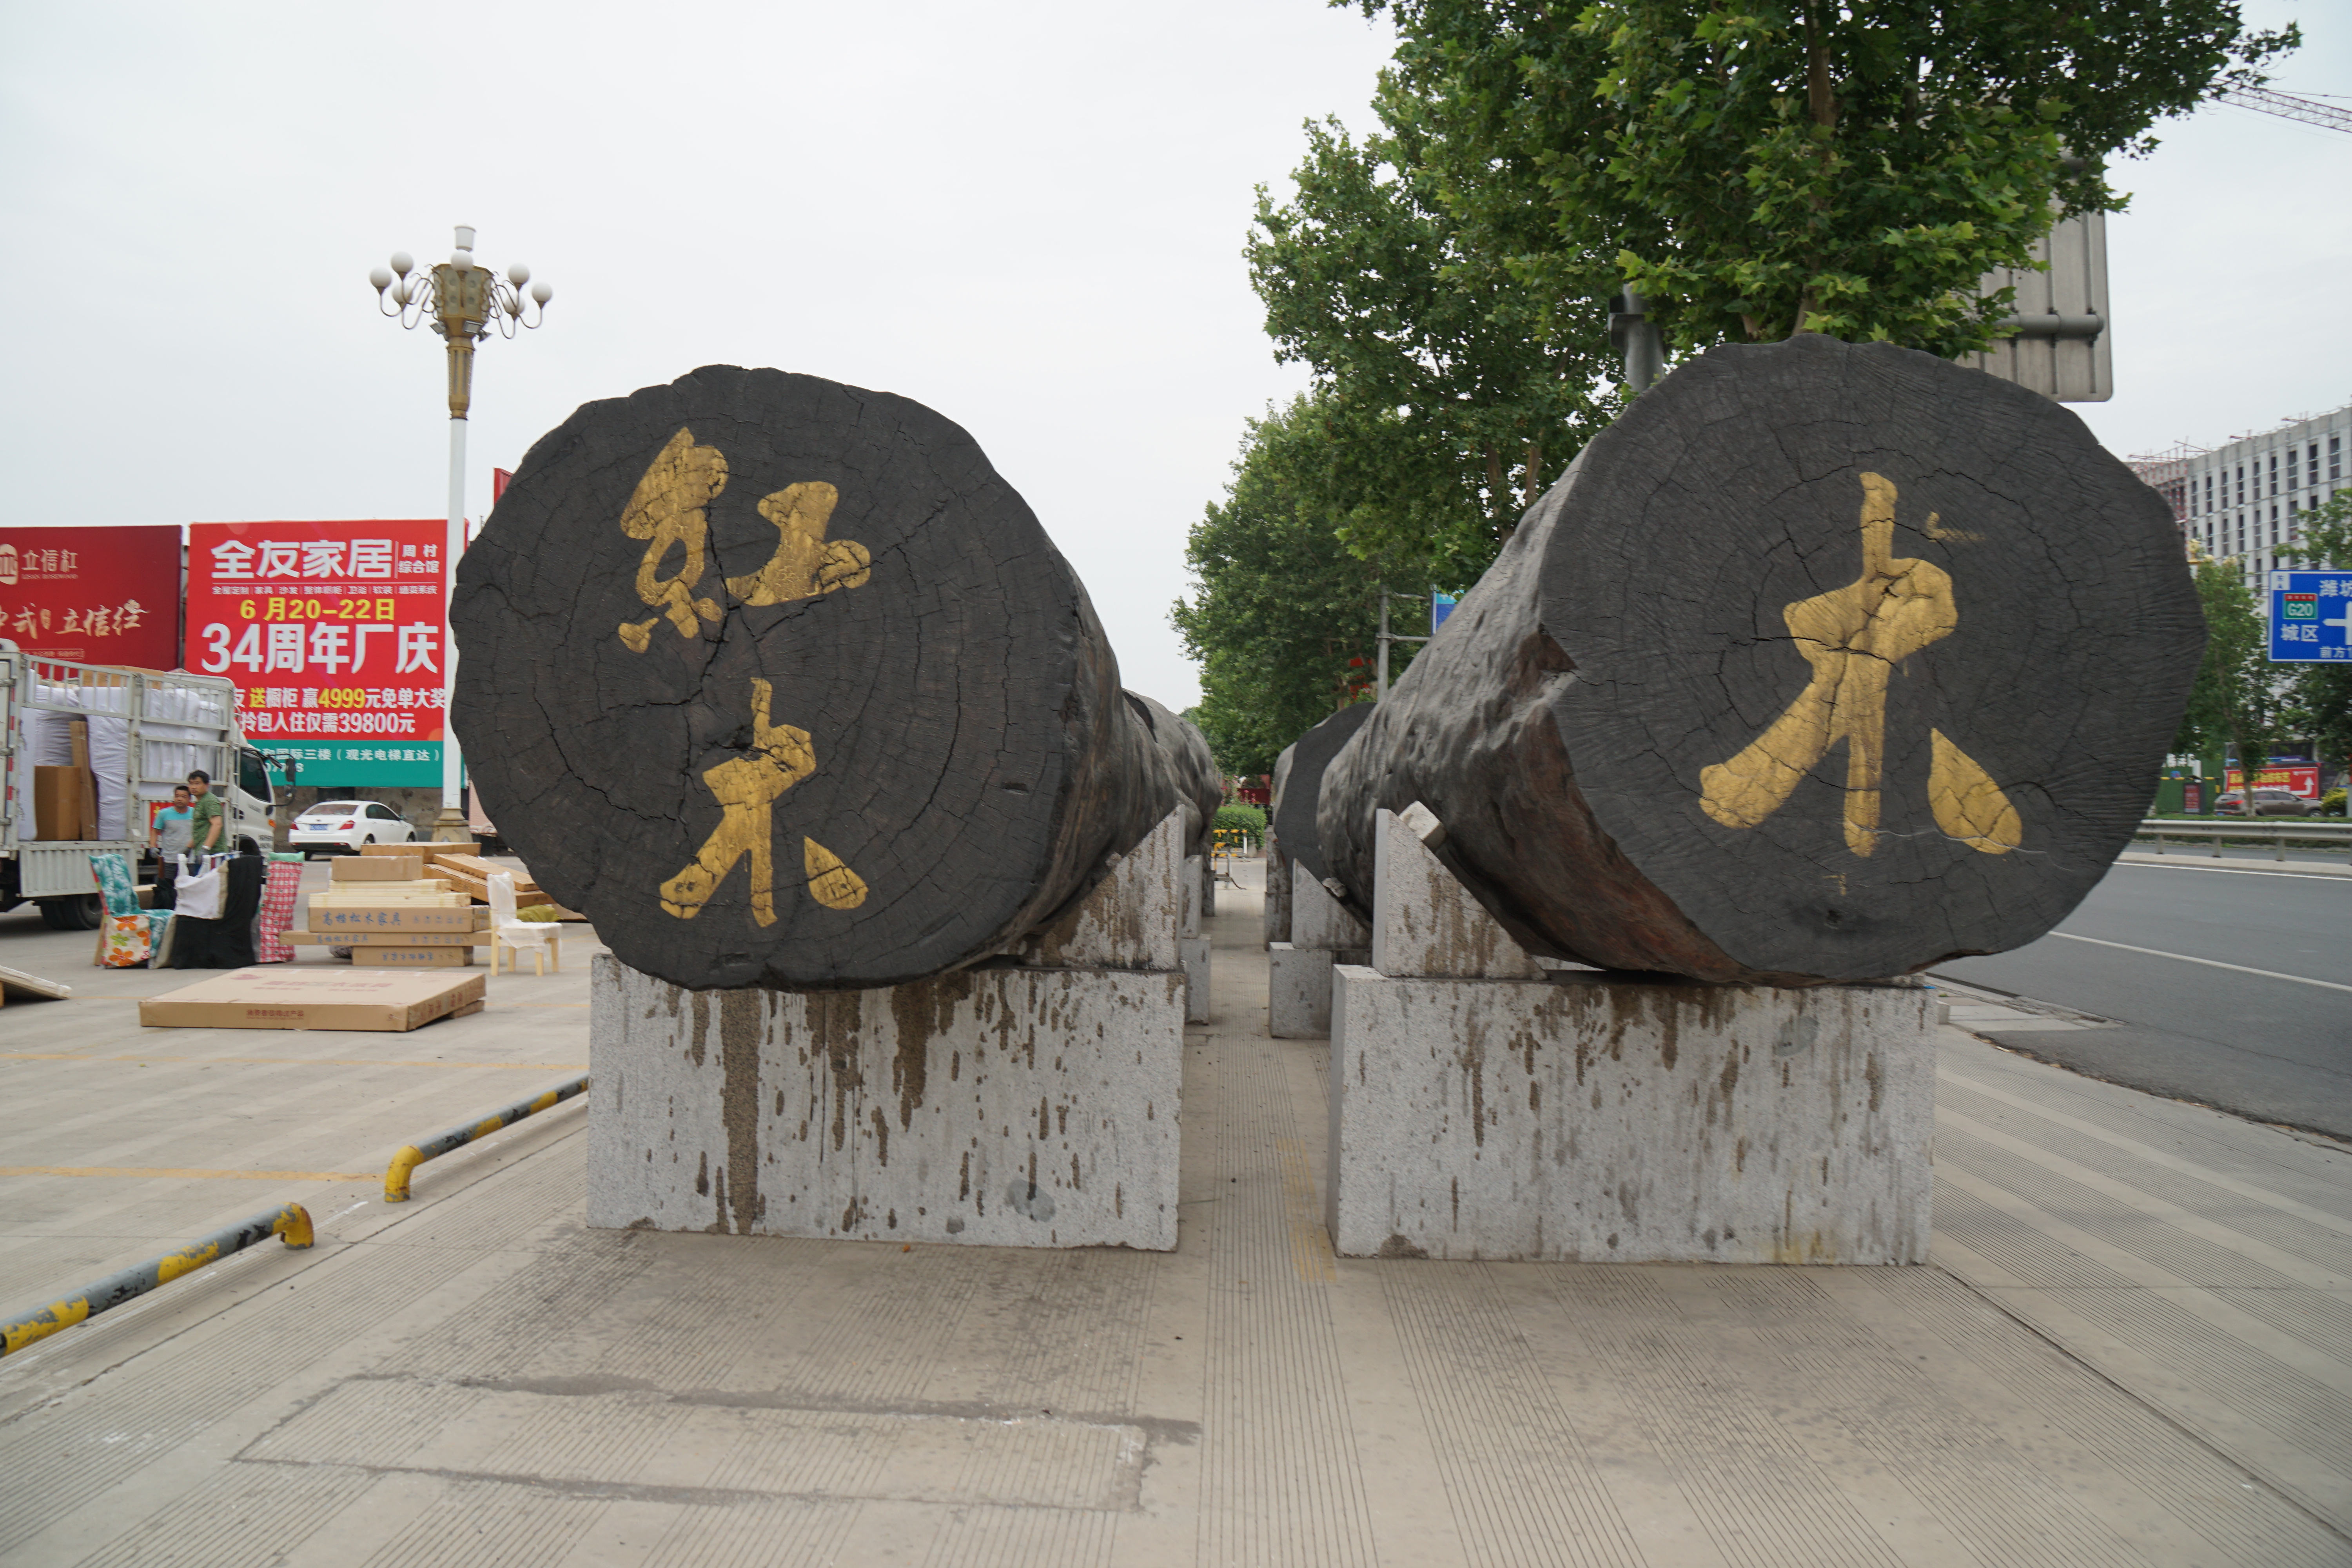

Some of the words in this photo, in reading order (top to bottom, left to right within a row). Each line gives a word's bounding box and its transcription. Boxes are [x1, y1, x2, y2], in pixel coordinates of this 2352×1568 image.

[211, 539, 393, 579] 全友家居
[402, 544, 437, 558] 周村
[398, 560, 439, 574] 综合馆
[254, 586, 274, 595] 家具
[279, 586, 299, 595] 沙发
[348, 586, 367, 595] 卫浴
[2287, 603, 2314, 616] G20
[2280, 624, 2319, 642] 城区
[201, 621, 439, 674] 34周年厂庆
[249, 687, 299, 708] 送橱柜
